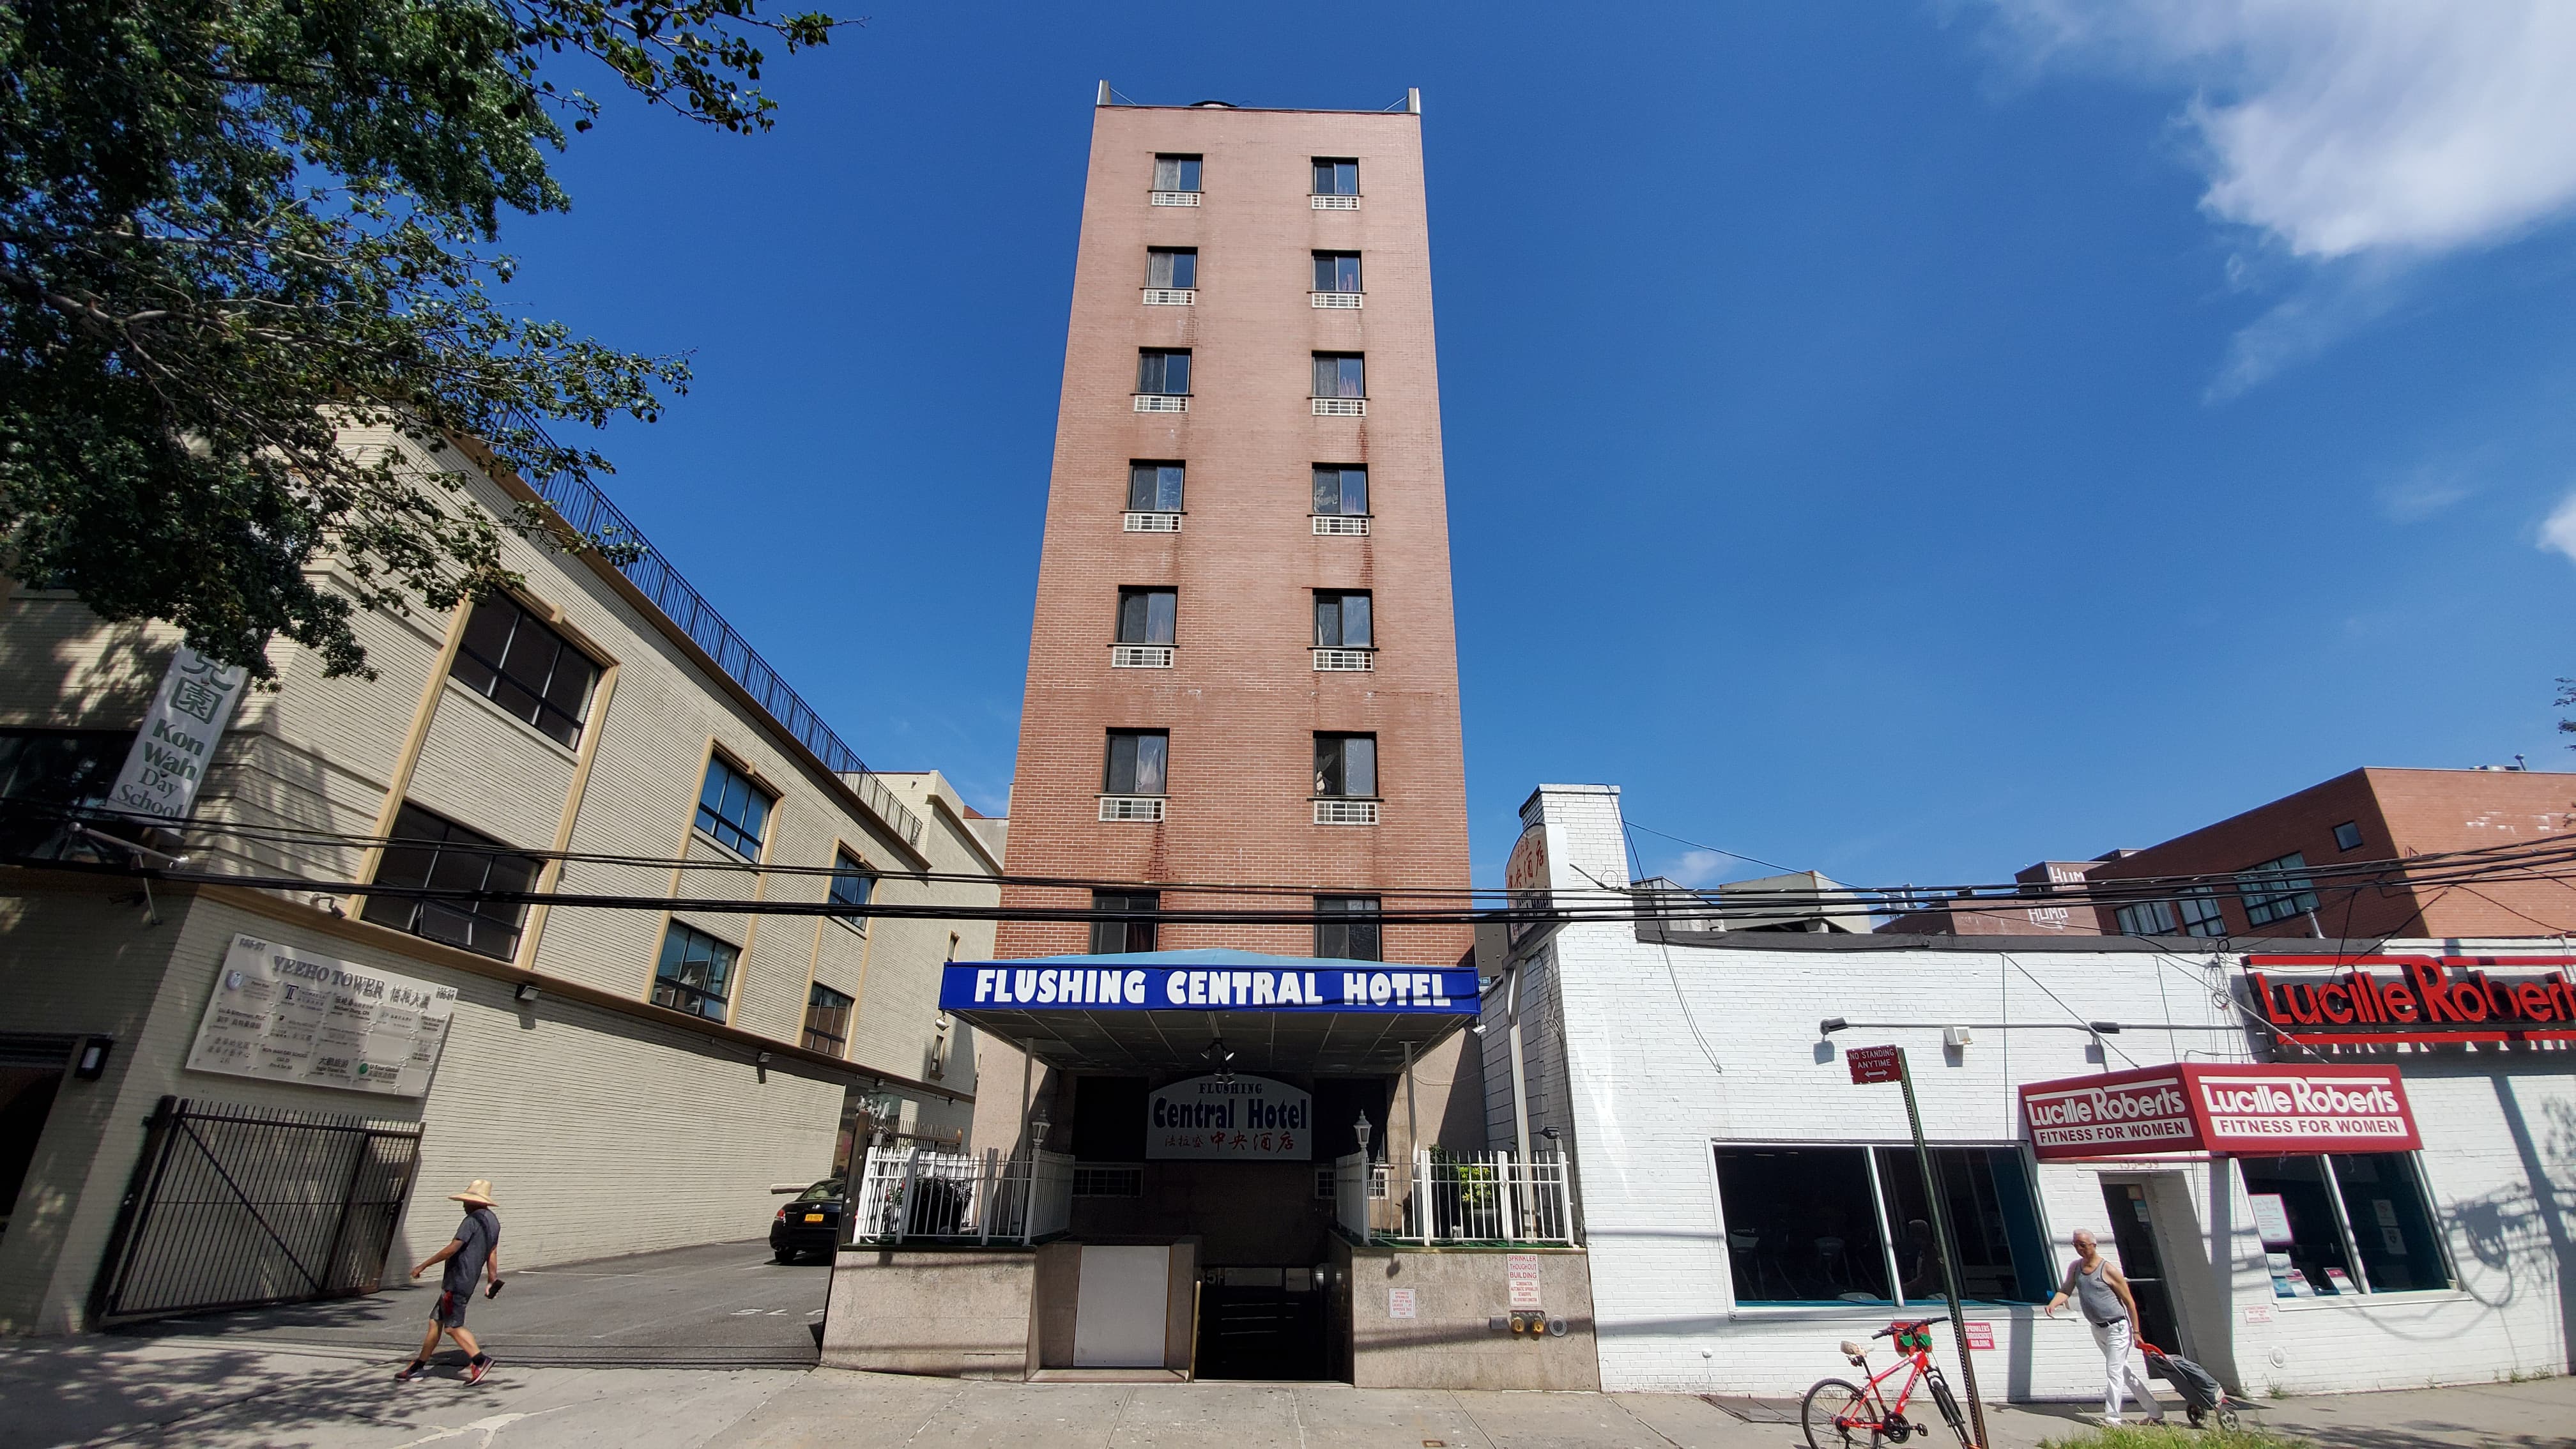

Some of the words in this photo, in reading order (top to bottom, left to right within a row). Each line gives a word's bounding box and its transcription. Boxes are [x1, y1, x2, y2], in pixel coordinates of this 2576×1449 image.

[153, 718, 204, 756] Kon
[144, 741, 197, 780] Wah
[139, 768, 179, 798] Day
[118, 784, 184, 818] School
[273, 956, 330, 983] YEEHO
[331, 970, 385, 998] TOWER
[974, 969, 1146, 1004] FLUSHING
[1166, 970, 1322, 1006] CENTRAL
[1344, 972, 1451, 1007] HOTEL
[2255, 971, 2418, 1025] Lucille
[2412, 956, 2576, 1023] Robert
[1850, 1052, 1859, 1061] NO
[1862, 1048, 1894, 1059] STANDING
[1857, 1059, 1892, 1069] ANYTIME
[1198, 1082, 1262, 1094] FLUSHING
[2200, 1084, 2292, 1113] Lucille
[2290, 1077, 2399, 1113] Roberts
[1153, 1097, 1235, 1129] Central
[1248, 1098, 1307, 1129] Hotel
[2027, 1098, 2092, 1126] Lucille
[2090, 1087, 2186, 1121] Roberts
[2039, 1128, 2093, 1144] FITNESS
[2096, 1126, 2125, 1140] FOR
[2128, 1121, 2186, 1138] WOMEN
[2220, 1119, 2293, 1133] FITNESS
[2300, 1119, 2333, 1133] FOR
[2337, 1119, 2400, 1133] WOMEN
